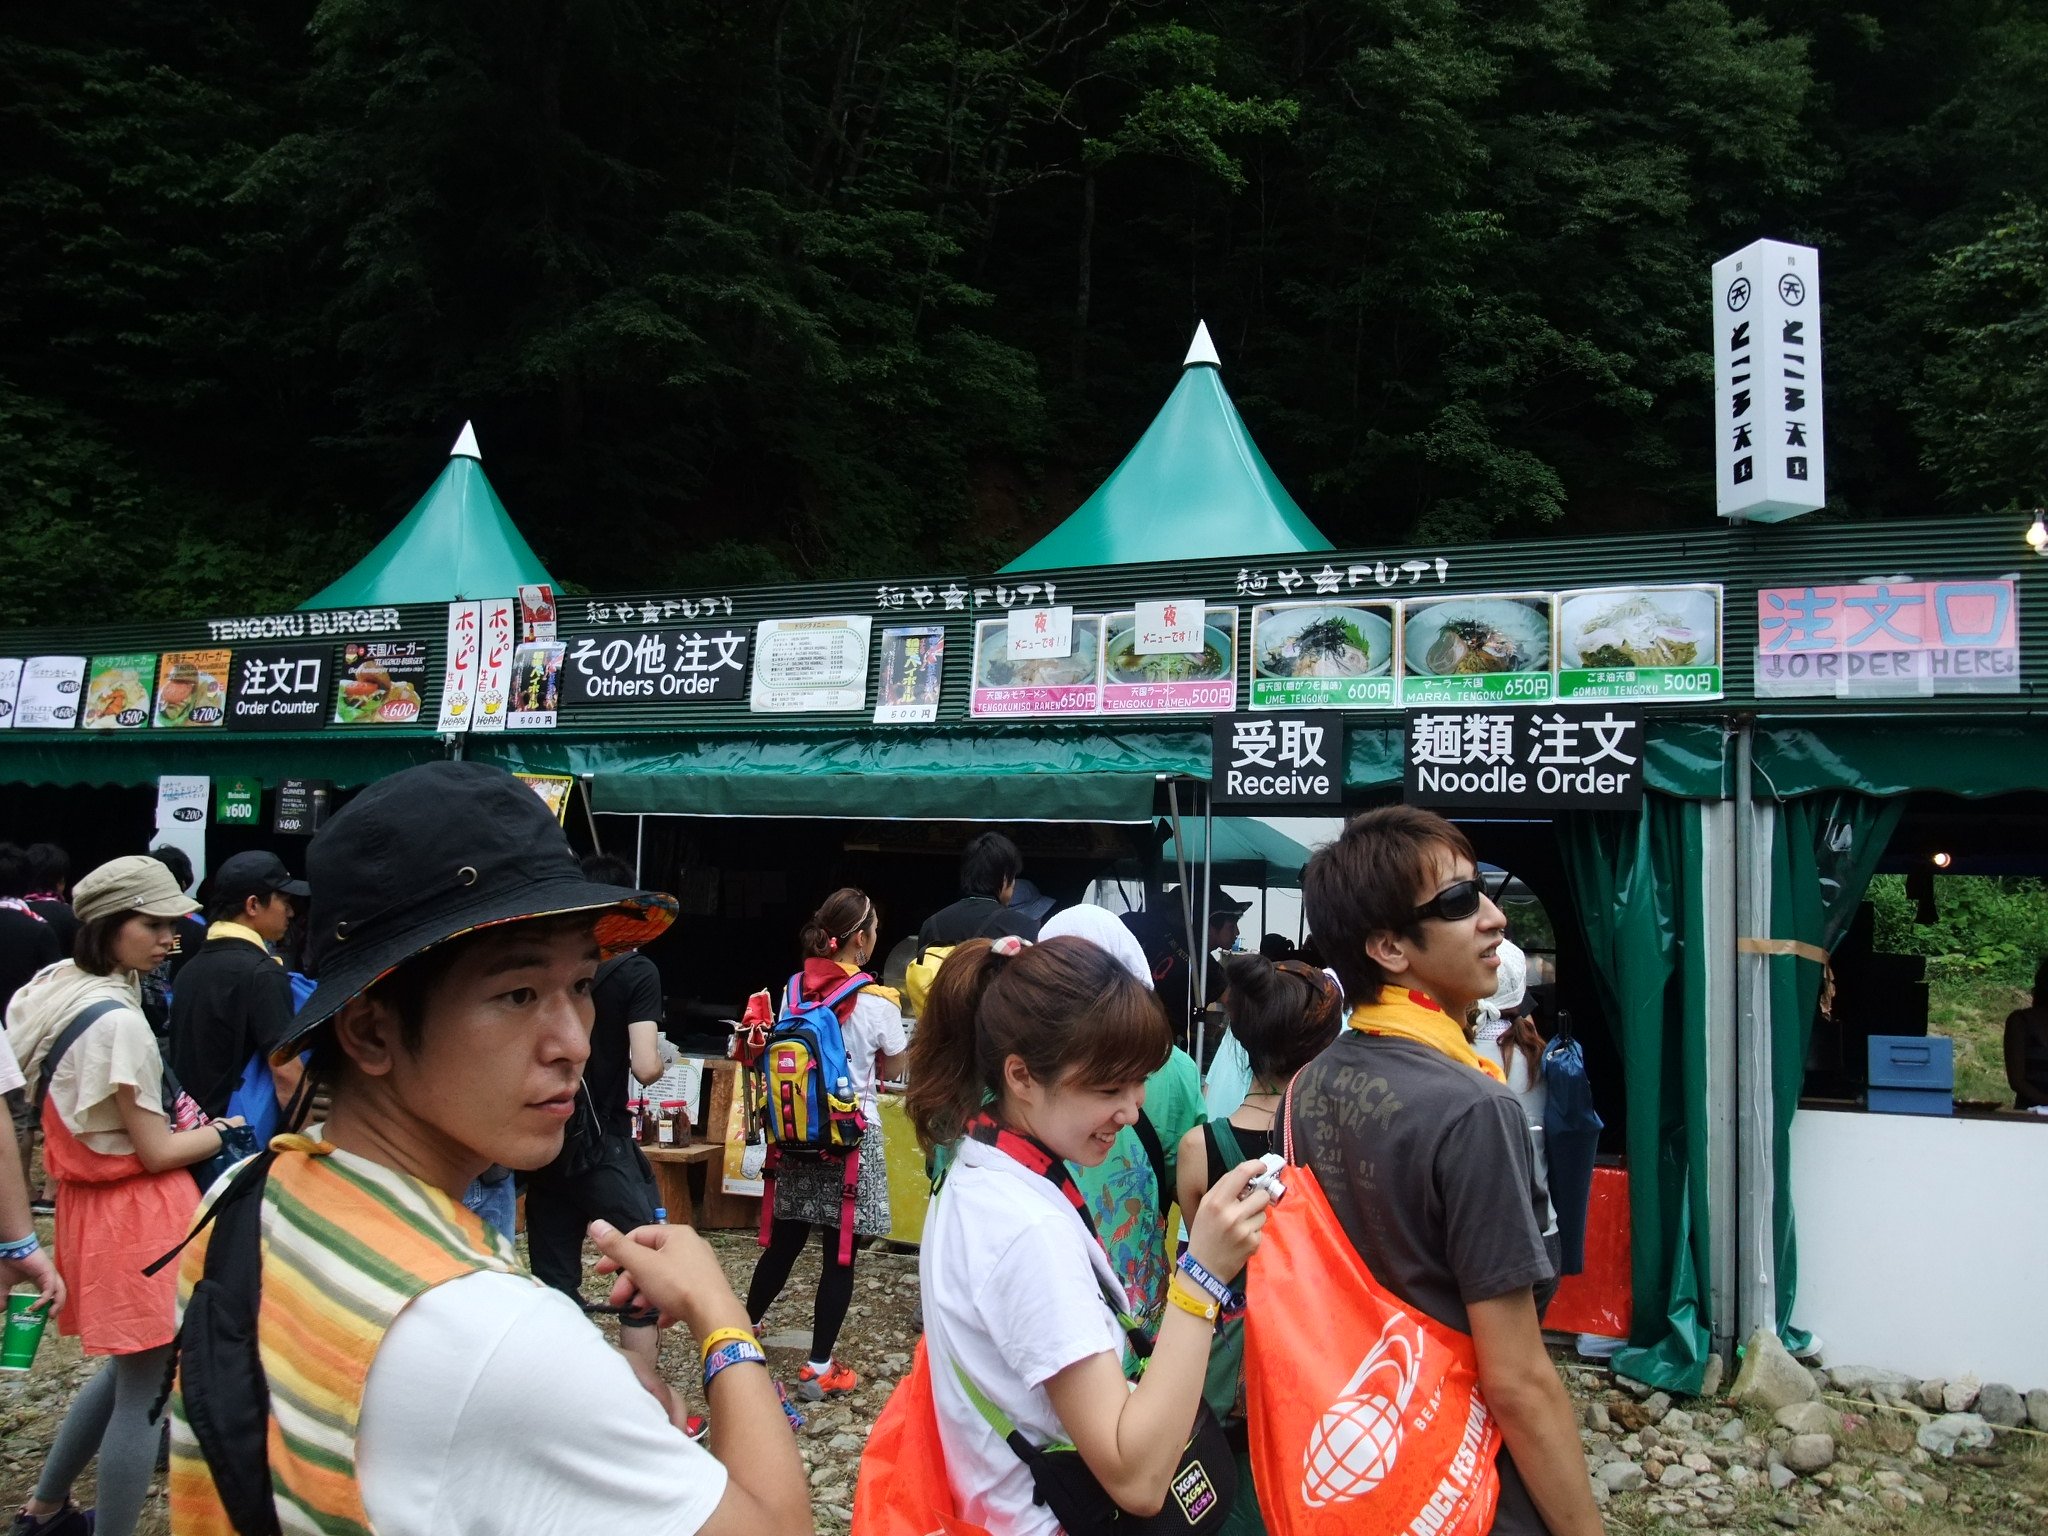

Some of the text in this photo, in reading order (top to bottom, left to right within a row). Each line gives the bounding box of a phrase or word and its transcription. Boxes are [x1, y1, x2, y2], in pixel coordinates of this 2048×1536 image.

[208, 608, 402, 641] TENGOKU BURGER
[1034, 612, 1047, 634] 夜
[1163, 605, 1177, 627] 夜
[1760, 584, 2010, 650] 注文口
[367, 643, 426, 657] 天国バーガー
[455, 606, 477, 691] ホッピー
[489, 603, 510, 689] ホッピー
[570, 634, 666, 675] その他
[674, 630, 746, 672] 注文
[1787, 650, 2004, 679] ORDER HERE
[240, 658, 322, 695] 注文口
[586, 673, 720, 697] Others Order
[1423, 678, 1484, 689] マーラー天国
[1587, 672, 1636, 682] ごま油天国
[1664, 673, 1711, 690] 500円
[1131, 687, 1177, 697] 天国ラーメン
[1348, 683, 1391, 700] 600円
[1504, 678, 1549, 696] 650円
[1572, 685, 1658, 697] GOMAYU TENGOKU
[1060, 692, 1097, 708] 650円
[1106, 699, 1191, 709] TENGOKU RAMEN
[1192, 688, 1231, 704] 500円
[1265, 694, 1329, 704] UME TENGOKU
[1406, 691, 1504, 701] MARRA TENGOKU
[192, 708, 220, 720] ¥700-
[236, 701, 319, 715] Order Counter
[383, 703, 417, 717] ¥600-
[891, 709, 931, 718] 500円
[1034, 701, 1061, 711] RAMEN
[475, 715, 503, 725] HOPPY
[1231, 720, 1327, 768] 受取
[1411, 713, 1637, 766] 麺類 注文
[1227, 770, 1330, 795] Receive
[1418, 766, 1631, 794] Noodle Order
[225, 804, 252, 818] ¥600
[1333, 1065, 1403, 1131] ROCK
[1203, 1276, 1226, 1301] ROCK
[1409, 1393, 1487, 1536] ROCK FESTIVAL
